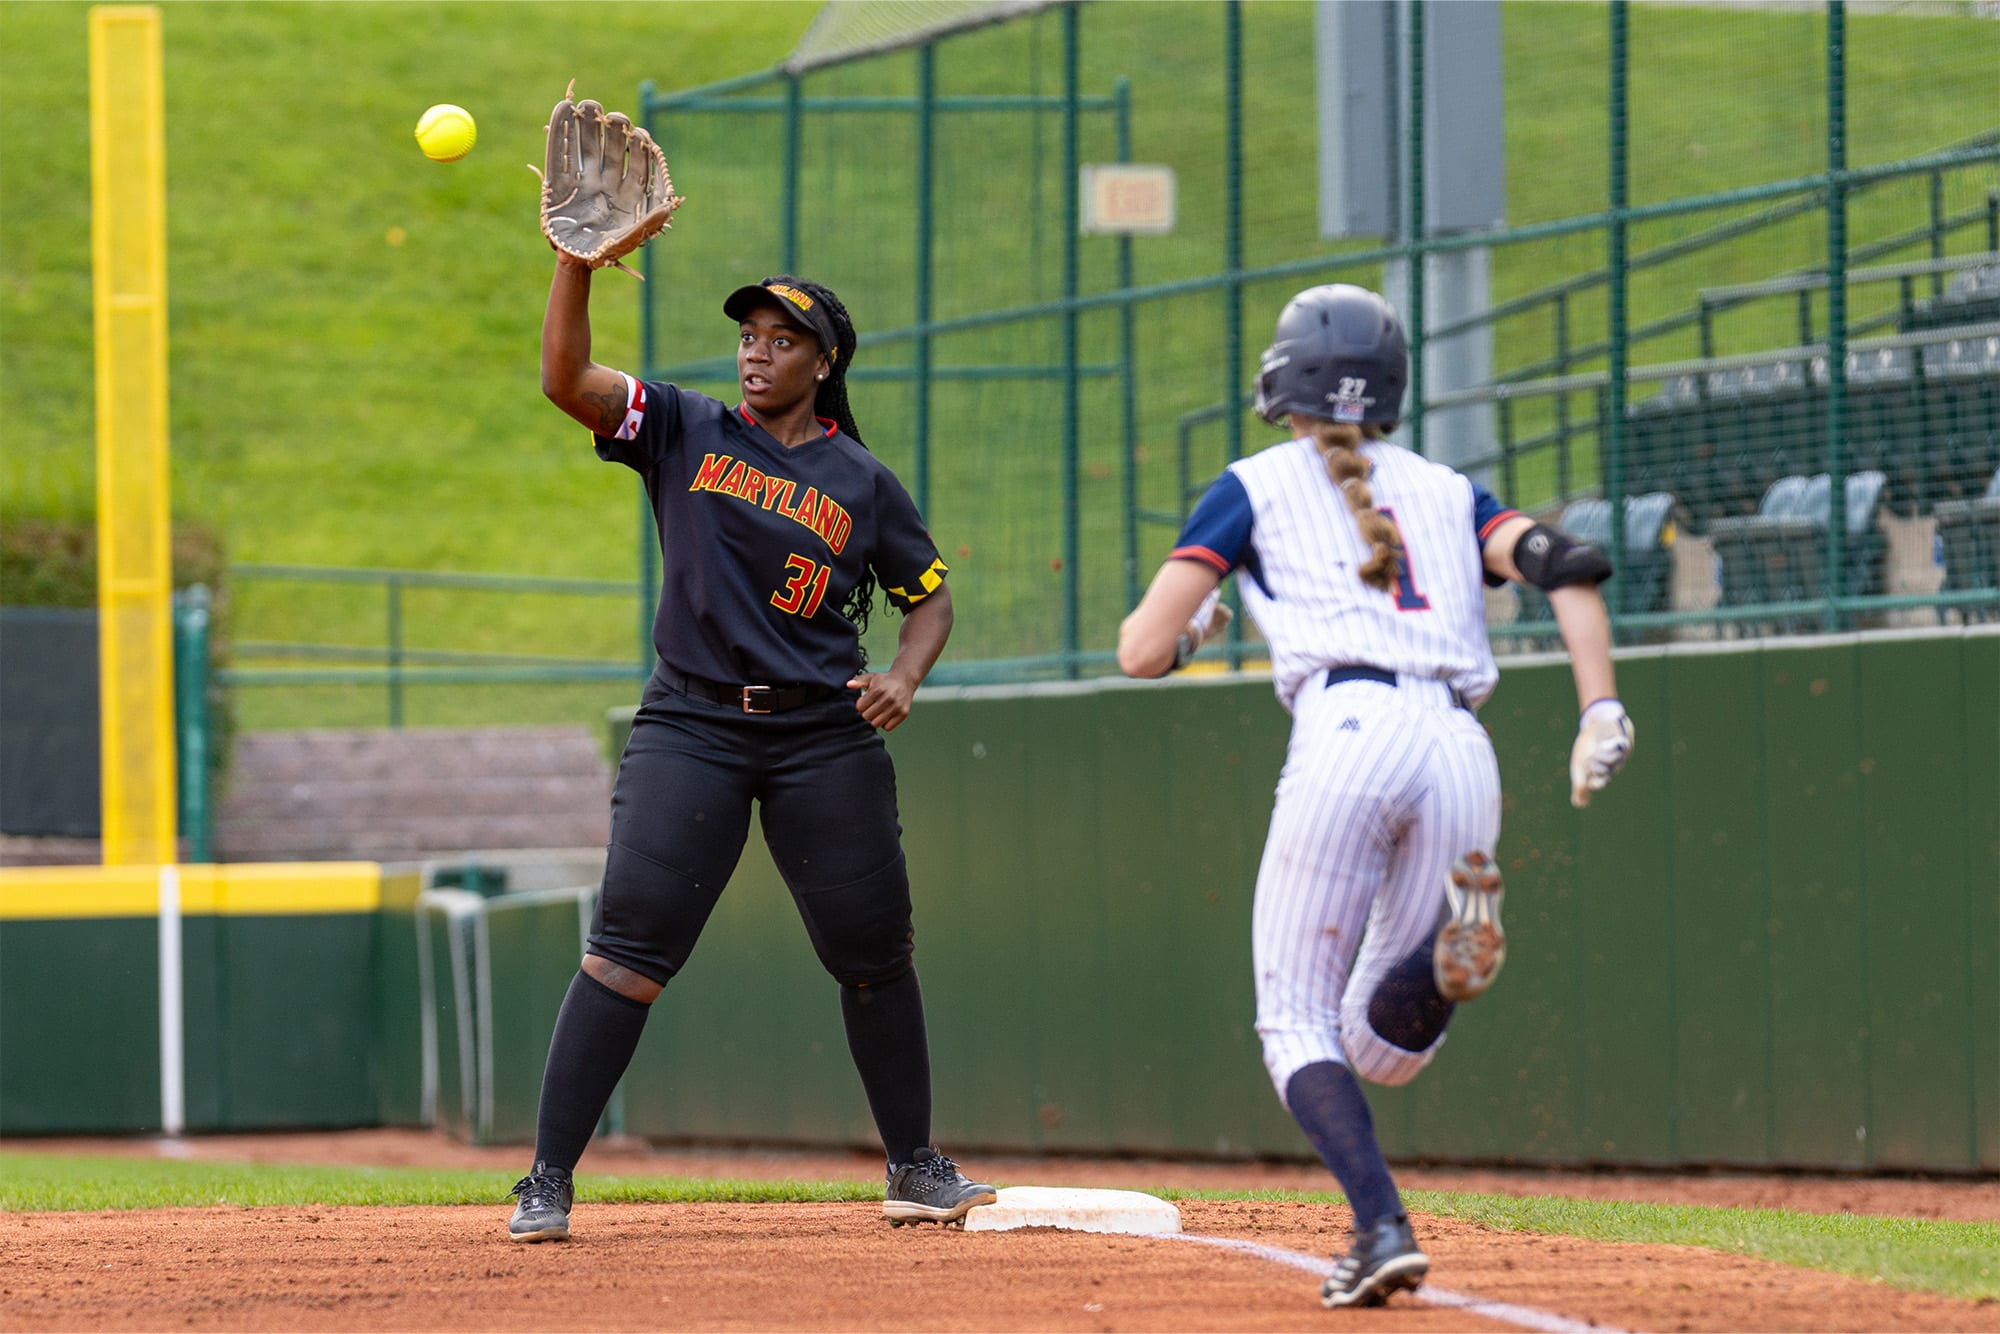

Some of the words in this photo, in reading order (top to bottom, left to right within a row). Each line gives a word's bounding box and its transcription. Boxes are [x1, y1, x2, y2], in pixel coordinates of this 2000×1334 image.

[767, 284, 813, 310] LAND
[1339, 377, 1367, 398] 27
[689, 453, 851, 555] MARYLAND
[770, 554, 831, 618] 31
